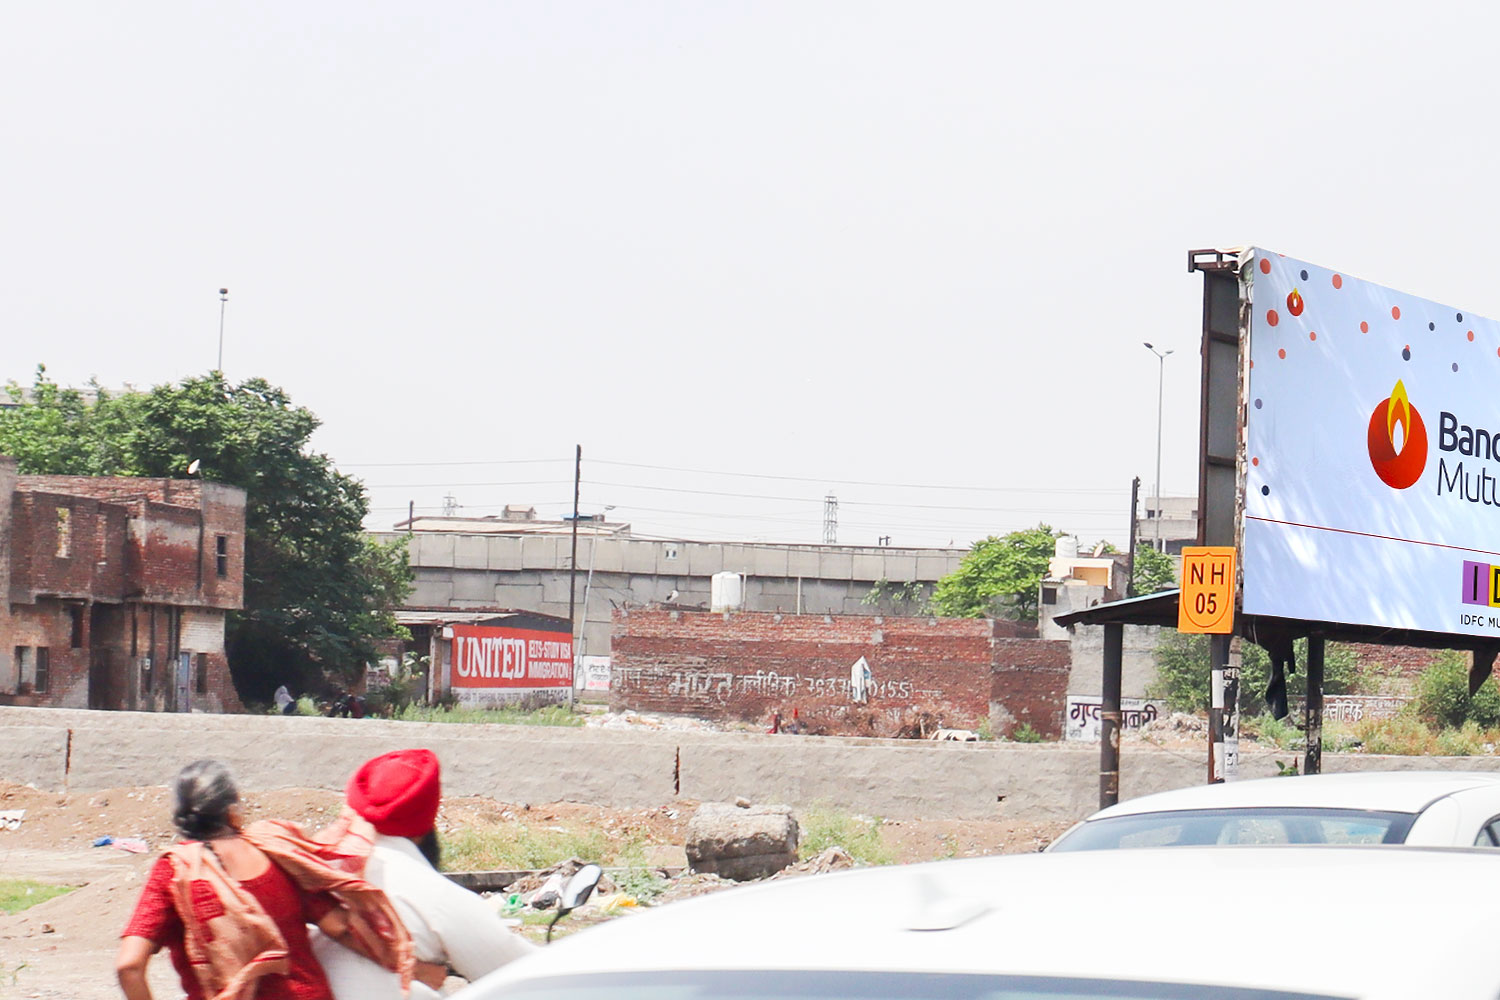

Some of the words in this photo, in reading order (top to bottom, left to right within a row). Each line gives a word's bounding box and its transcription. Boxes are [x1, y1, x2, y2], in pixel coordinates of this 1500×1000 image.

[1190, 562, 1225, 586] NH
[1195, 592, 1217, 615] 05
[1460, 614, 1484, 627] IDFC
[457, 636, 525, 680] UNITED
